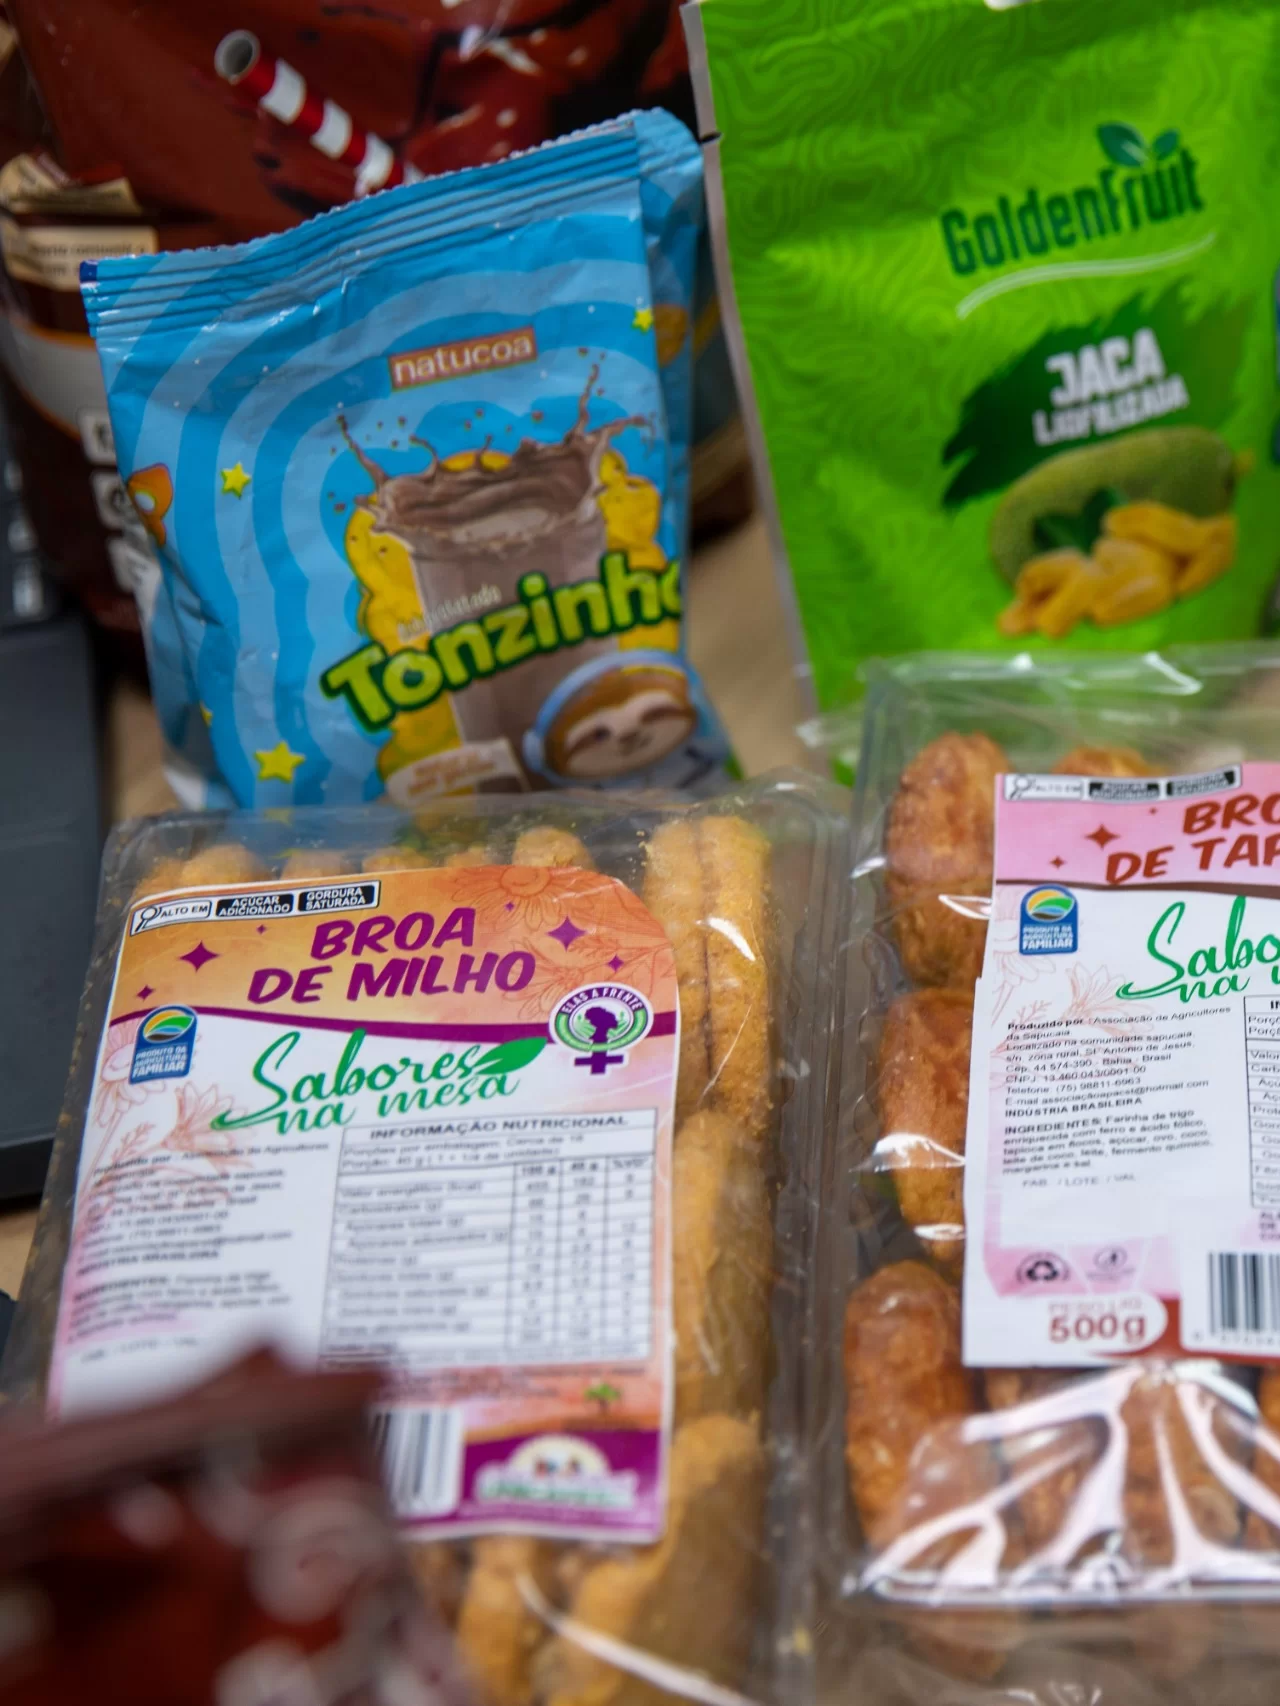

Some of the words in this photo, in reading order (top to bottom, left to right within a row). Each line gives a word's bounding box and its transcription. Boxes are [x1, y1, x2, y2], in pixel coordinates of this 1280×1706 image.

[394, 333, 532, 386] natucoa
[1046, 326, 1166, 407] JACA
[1105, 845, 1175, 885] DE
[231, 894, 280, 907] AÇÚCAR
[306, 886, 364, 902] GORDURA
[160, 904, 189, 919] ALTO
[191, 903, 209, 915] EM
[217, 904, 291, 918] ADICIONADO
[305, 896, 366, 911] SATURADA
[309, 906, 478, 962] BROA
[1022, 938, 1073, 950] FAMILIAR
[246, 963, 333, 1006] DE
[345, 948, 538, 1003] MILHO
[1178, 973, 1251, 1004] na
[561, 992, 589, 1013] ELAS
[602, 987, 643, 1012] FRENTE
[1007, 1019, 1063, 1031] Produzido
[1065, 1018, 1084, 1028] por
[1093, 1013, 1153, 1025] Associação
[1155, 1013, 1169, 1022] de
[1170, 1006, 1232, 1022] Agricultores
[1006, 1040, 1062, 1052] Localizado
[1080, 1034, 1144, 1046] comunidade
[135, 1046, 174, 1060] PRODUTO
[1141, 1053, 1172, 1064] Brasil
[1250, 1050, 1280, 1061] Valor
[132, 1061, 187, 1078] FAMILIAR
[214, 1028, 487, 1126] Sabores
[276, 1101, 358, 1137] na
[378, 1072, 521, 1120] mesa
[1005, 1104, 1069, 1118] INDÚSTRIA
[1071, 1096, 1143, 1113] BRASILEIRA
[1105, 1112, 1149, 1124] Farinha
[1152, 1112, 1166, 1121] de
[1169, 1109, 1195, 1120] trigo
[368, 1119, 498, 1141] INFORMAÇÃO
[501, 1115, 629, 1132] NUTRICIONAL
[1072, 1128, 1097, 1139] com
[1099, 1125, 1126, 1136] ferro
[1140, 1122, 1170, 1134] ácido
[1003, 1145, 1045, 1157] tapioca
[1111, 1144, 1163, 1157] fermento
[1050, 1314, 1147, 1344] 500g
